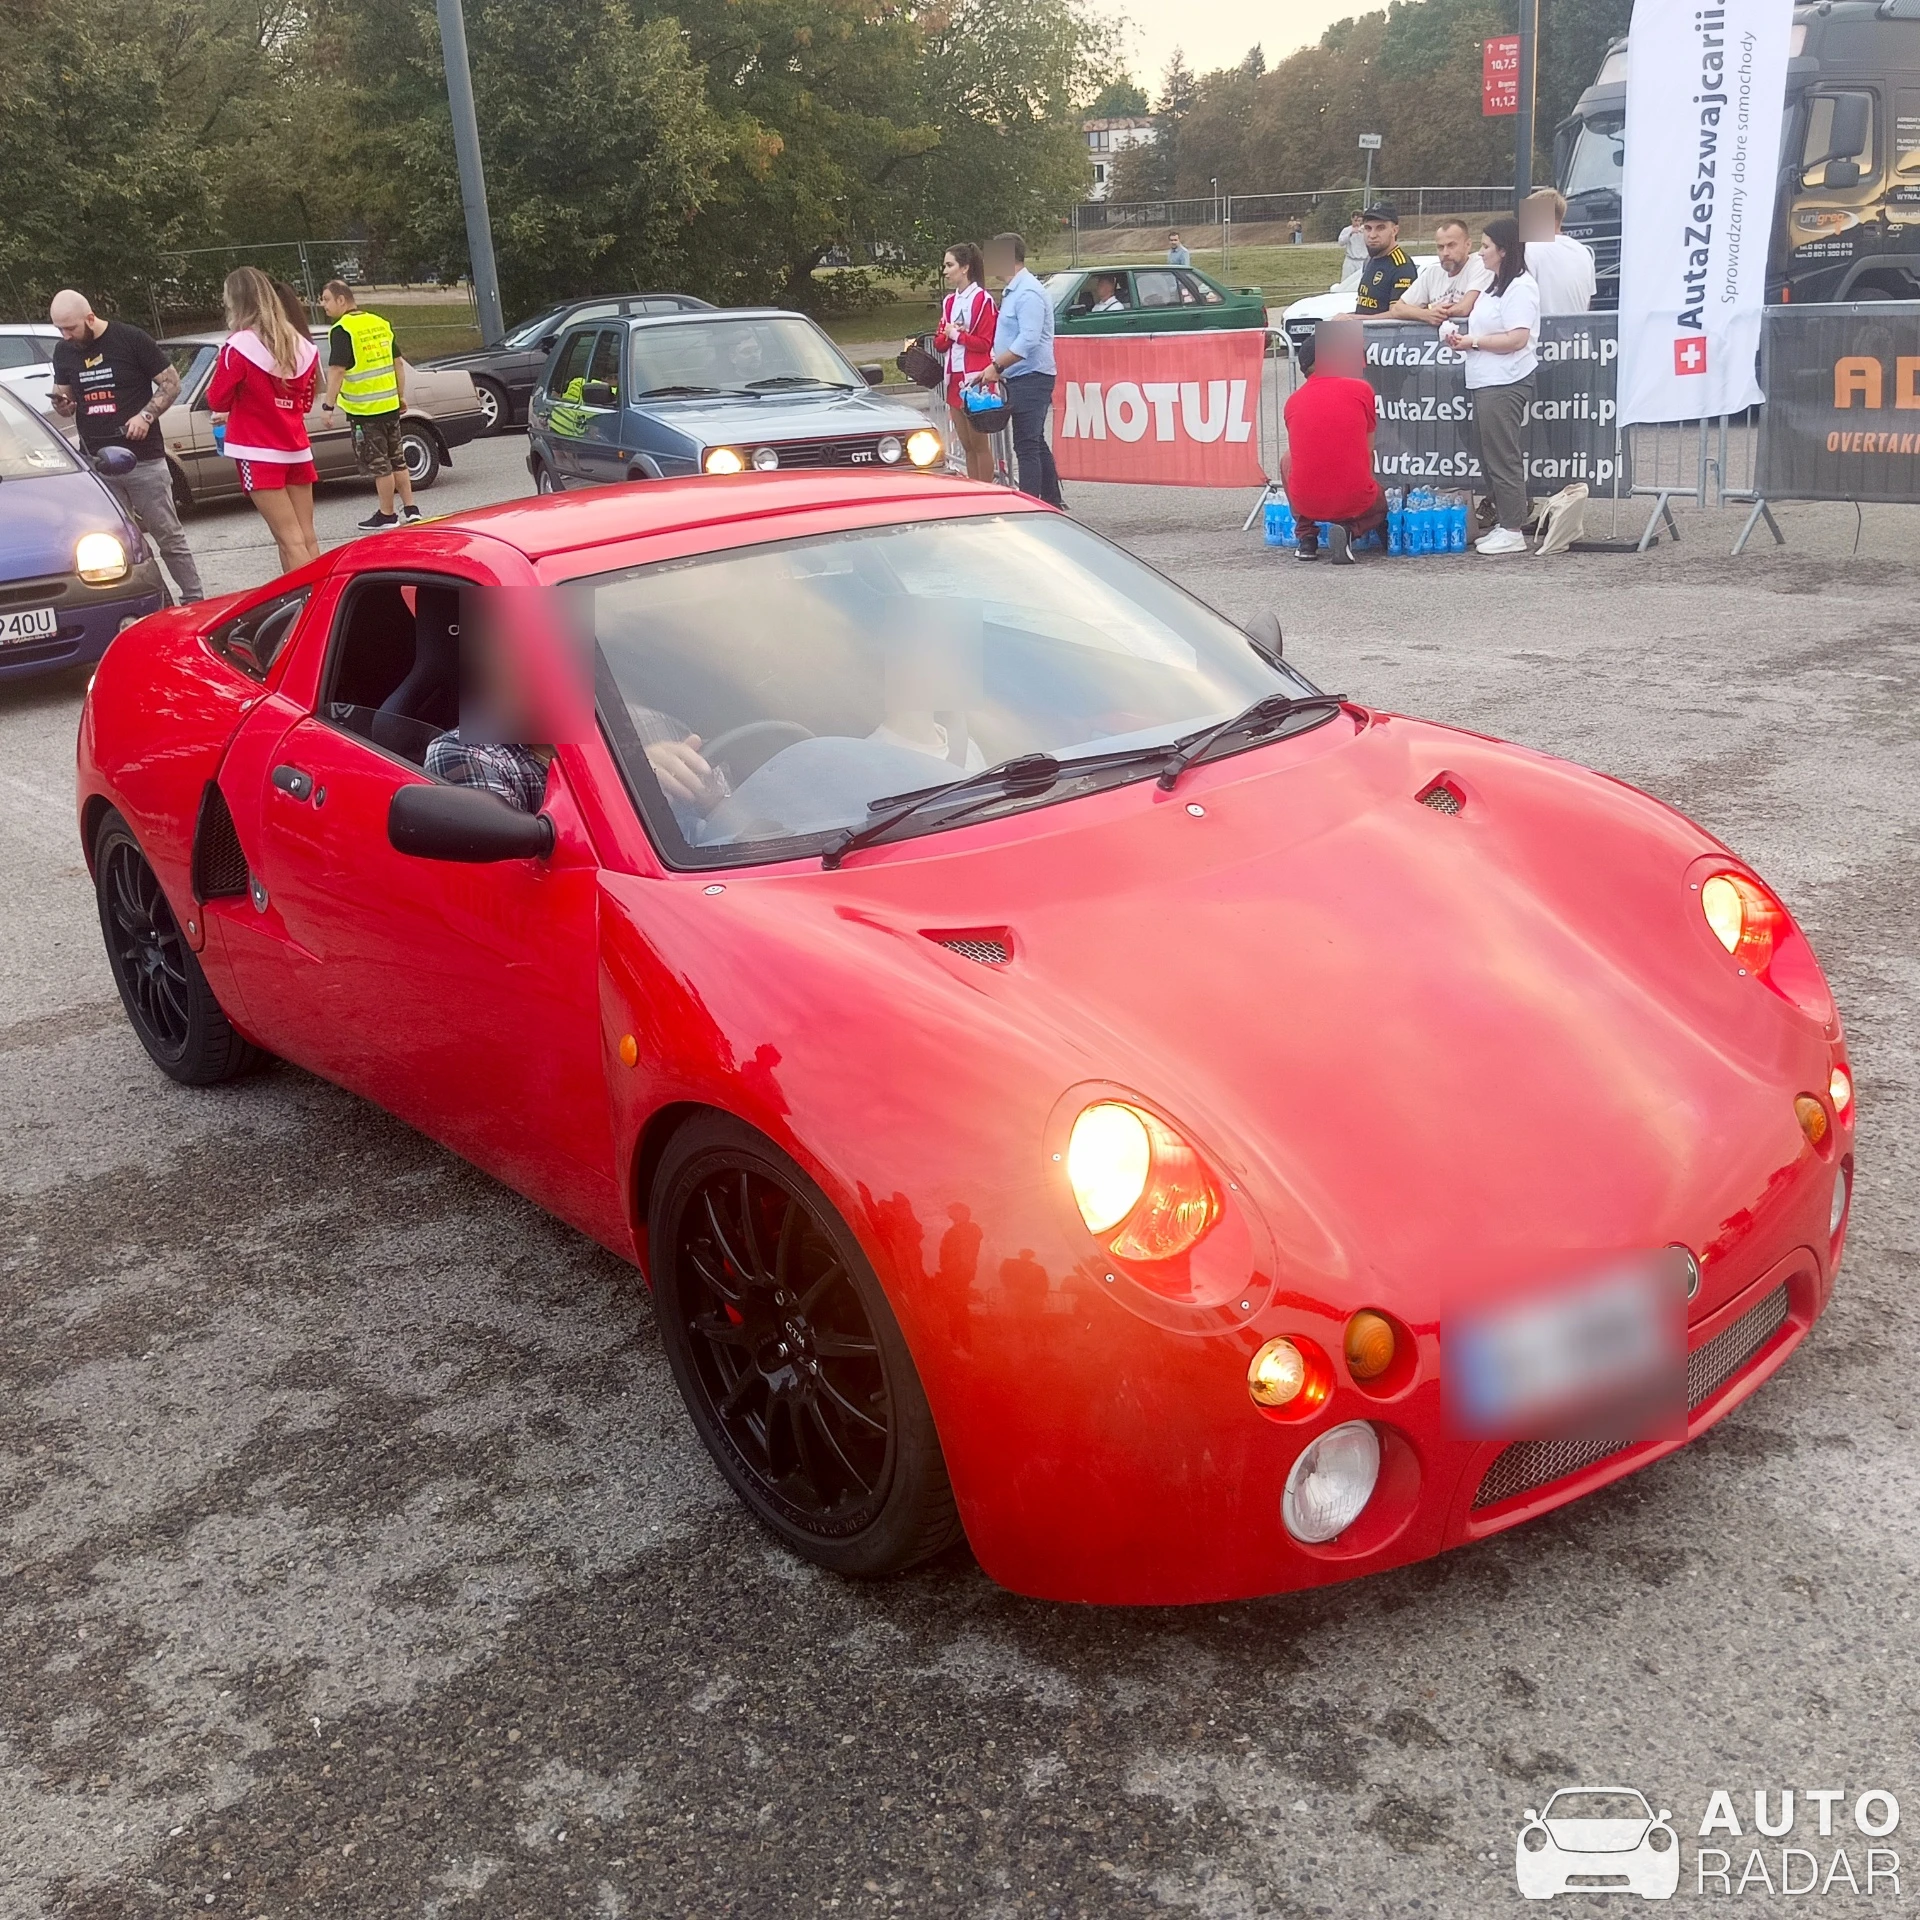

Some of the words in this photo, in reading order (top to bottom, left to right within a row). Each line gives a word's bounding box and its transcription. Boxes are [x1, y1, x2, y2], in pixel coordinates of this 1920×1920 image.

[1491, 59, 1517, 71] 10,7,5
[1738, 31, 1757, 131] samochody
[1490, 95, 1516, 107] 11,1,2
[1731, 135, 1749, 183] dobre
[1563, 228, 1593, 237] OLVO
[1721, 187, 1748, 304] Sprowadzamy
[1061, 379, 1252, 443] MOTUL
[851, 451, 873, 463] GTI
